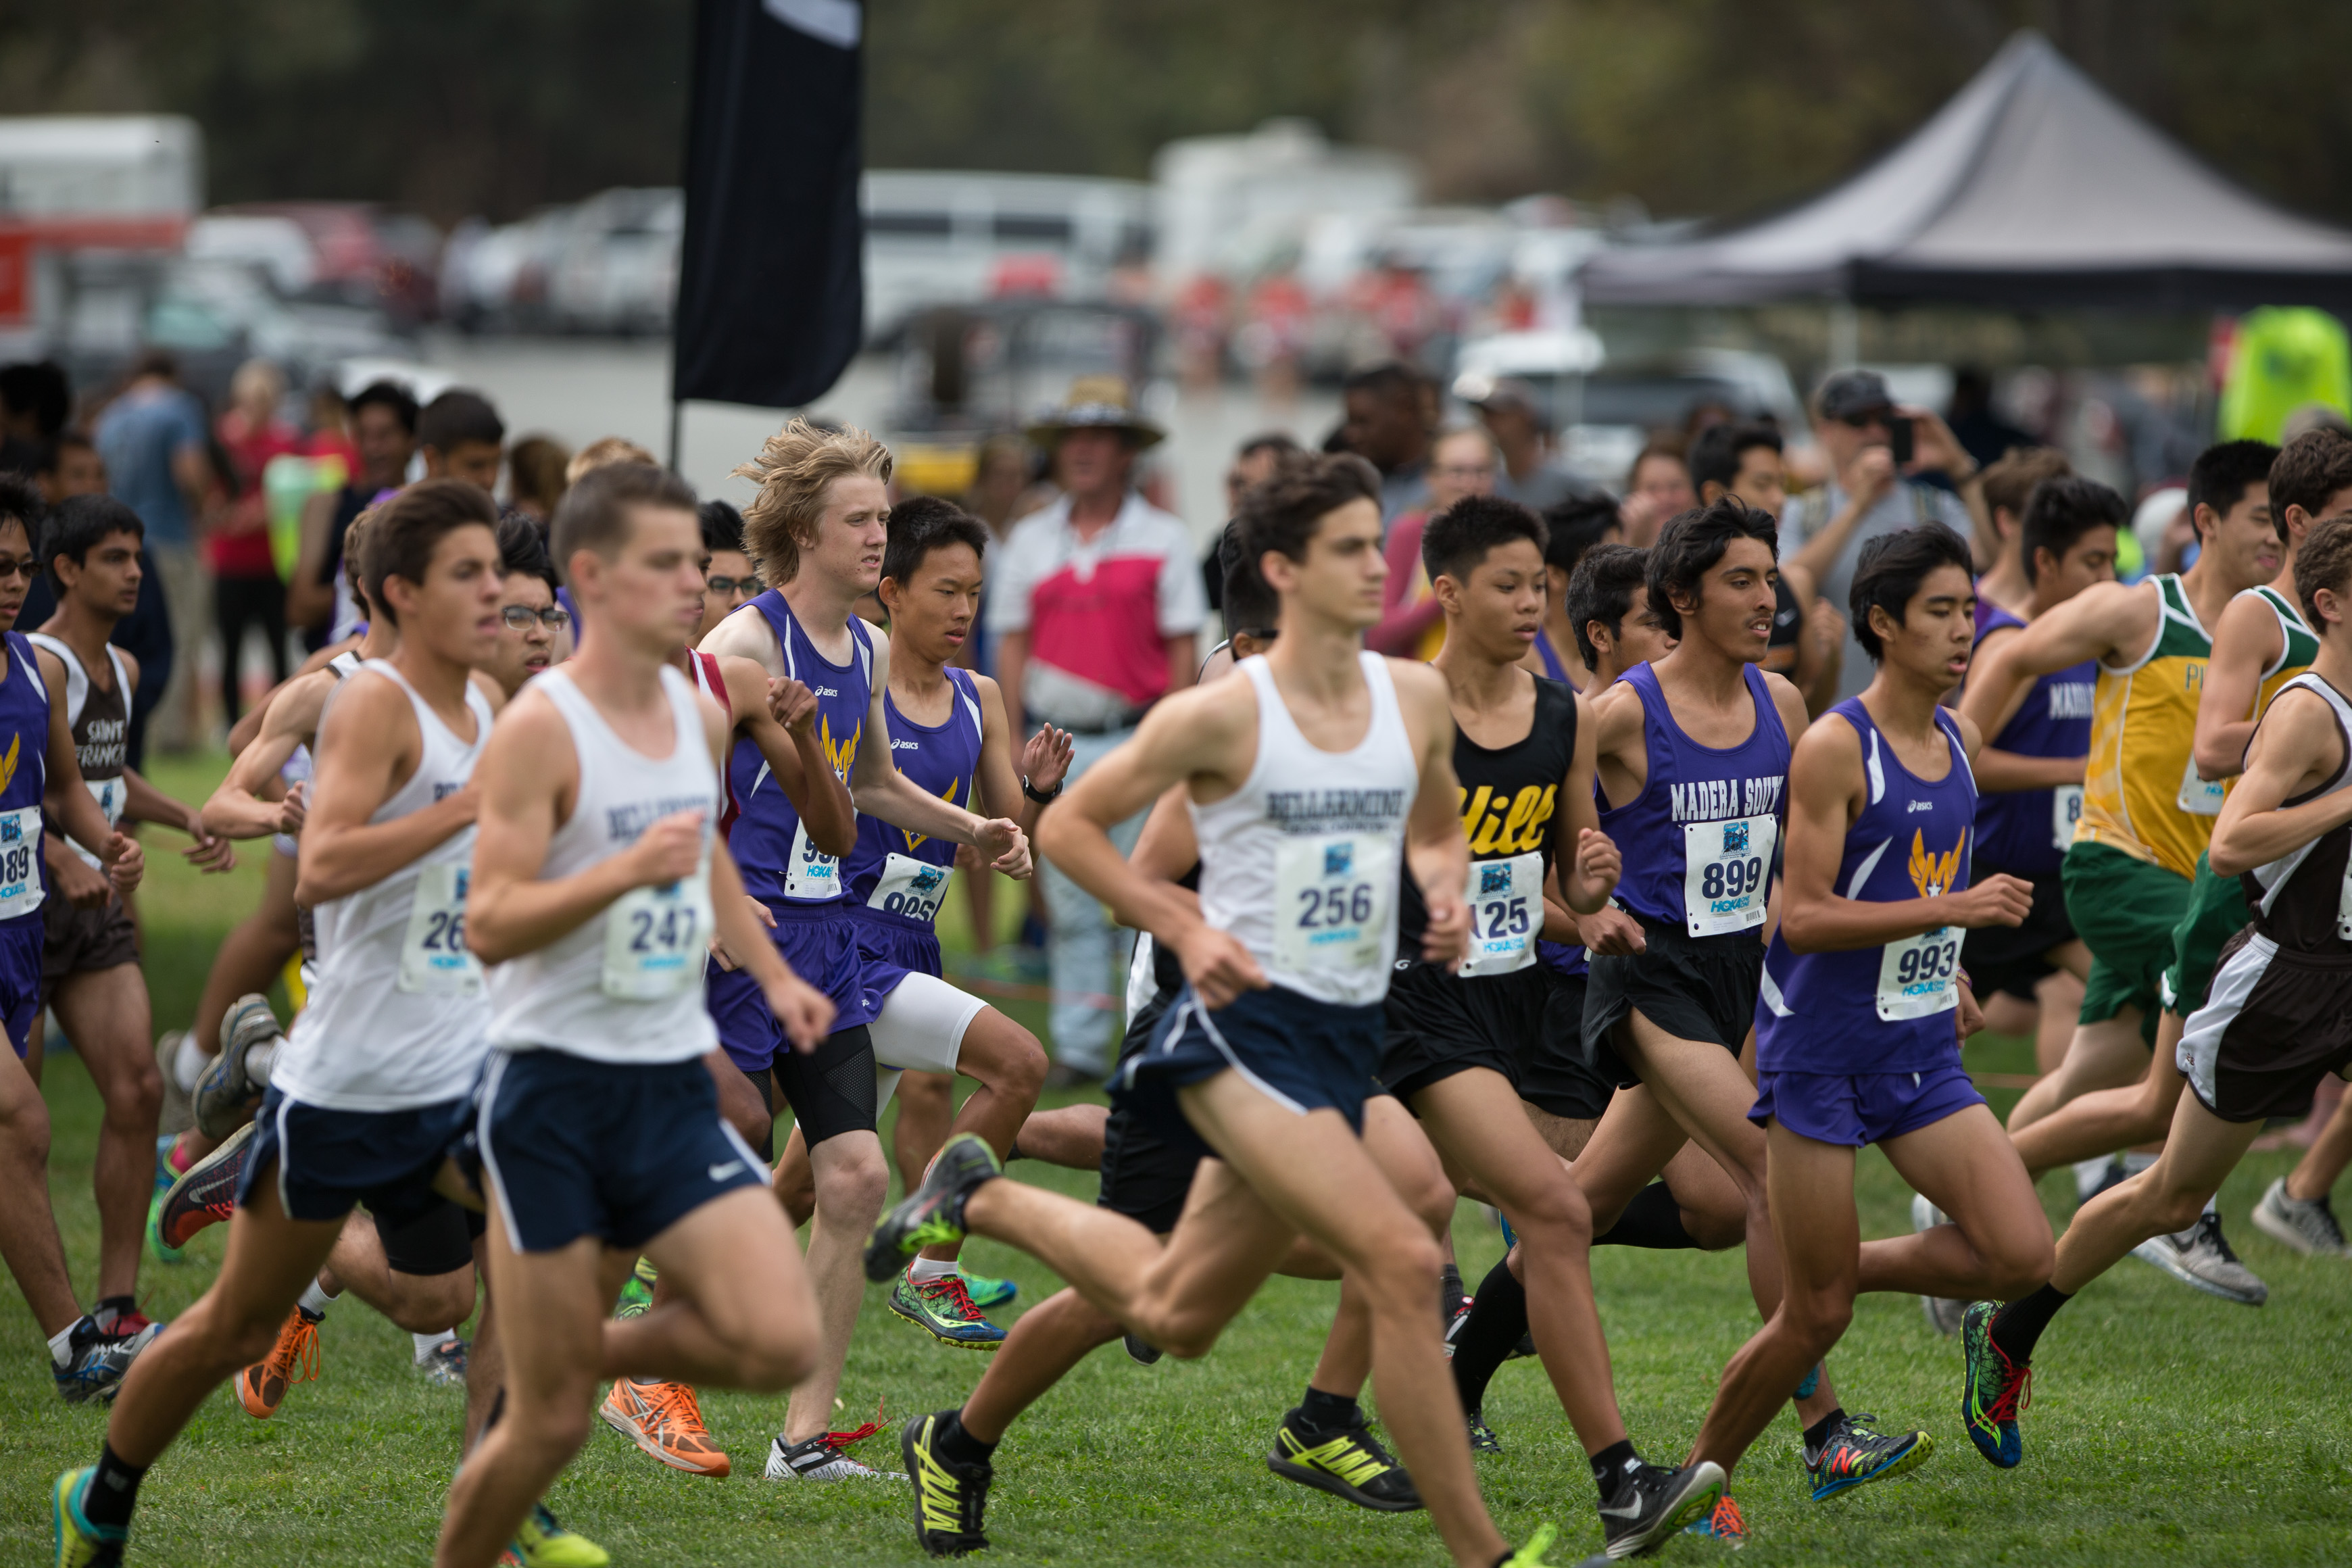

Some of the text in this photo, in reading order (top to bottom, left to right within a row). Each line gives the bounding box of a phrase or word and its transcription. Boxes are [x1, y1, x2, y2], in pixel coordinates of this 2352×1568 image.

[87, 718, 124, 743] SAINT
[1671, 779, 1739, 821] MADERA
[806, 865, 830, 877] HOKA
[1702, 856, 1762, 899] 899
[1298, 883, 1372, 927] 256
[1711, 898, 1742, 912] HOKA
[423, 911, 466, 950] 26
[630, 908, 696, 952] 247
[1898, 940, 1957, 984] 993
[1902, 982, 1934, 997] HOKA
